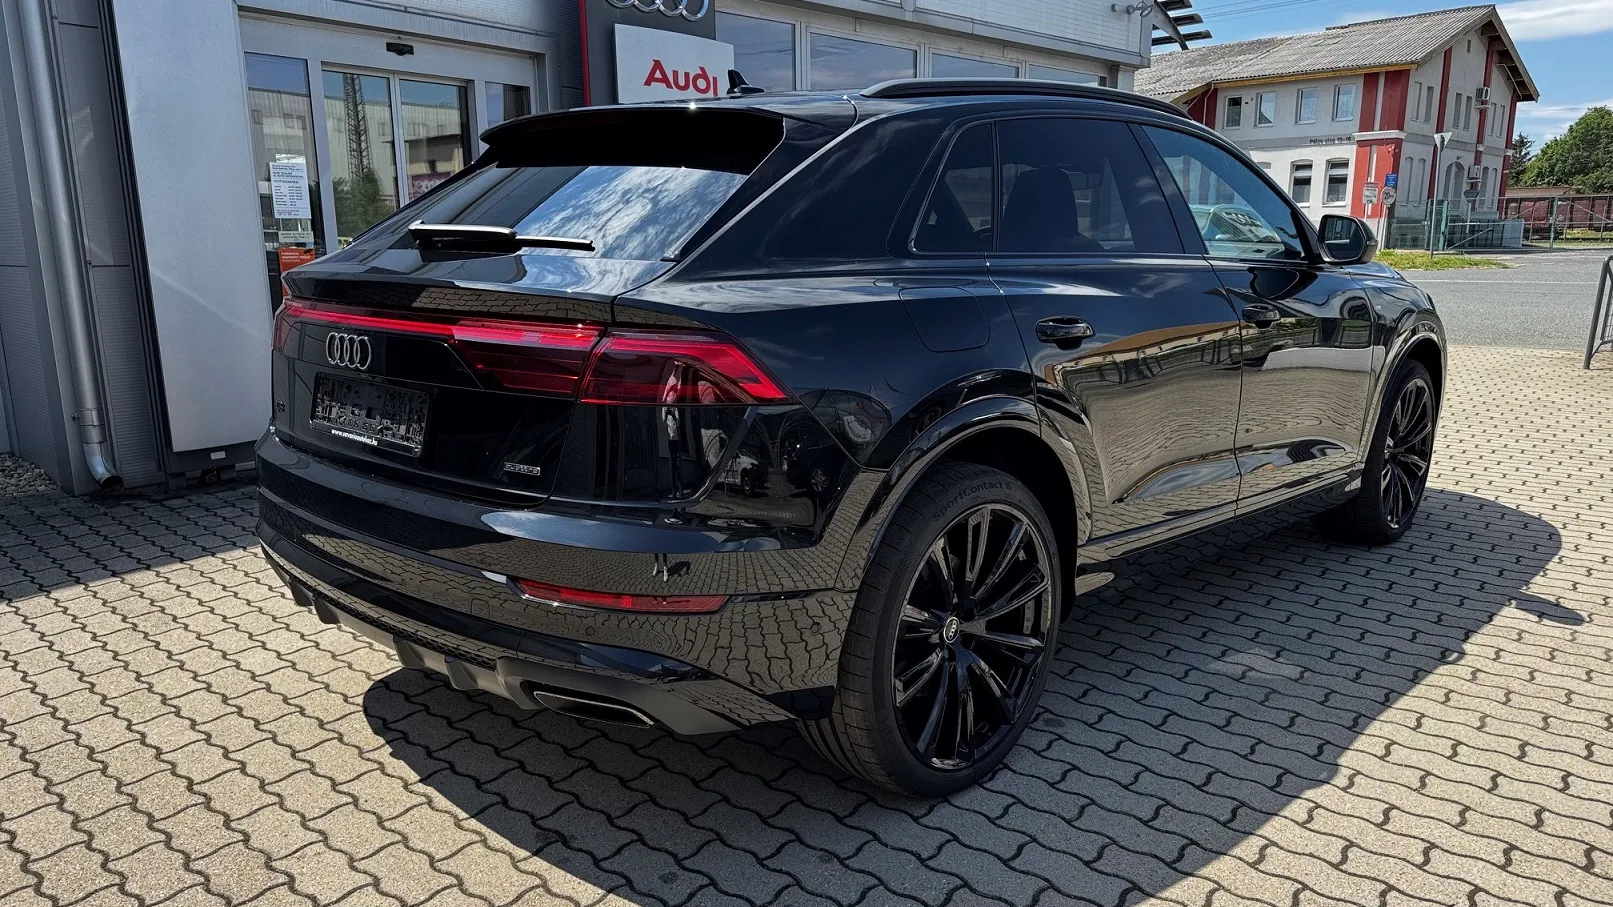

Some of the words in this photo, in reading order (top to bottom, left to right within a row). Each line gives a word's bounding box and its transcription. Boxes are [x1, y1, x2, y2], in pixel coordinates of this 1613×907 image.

[643, 59, 718, 97] Audi
[932, 480, 1003, 522] SportContact
[1005, 482, 1013, 491] 6
